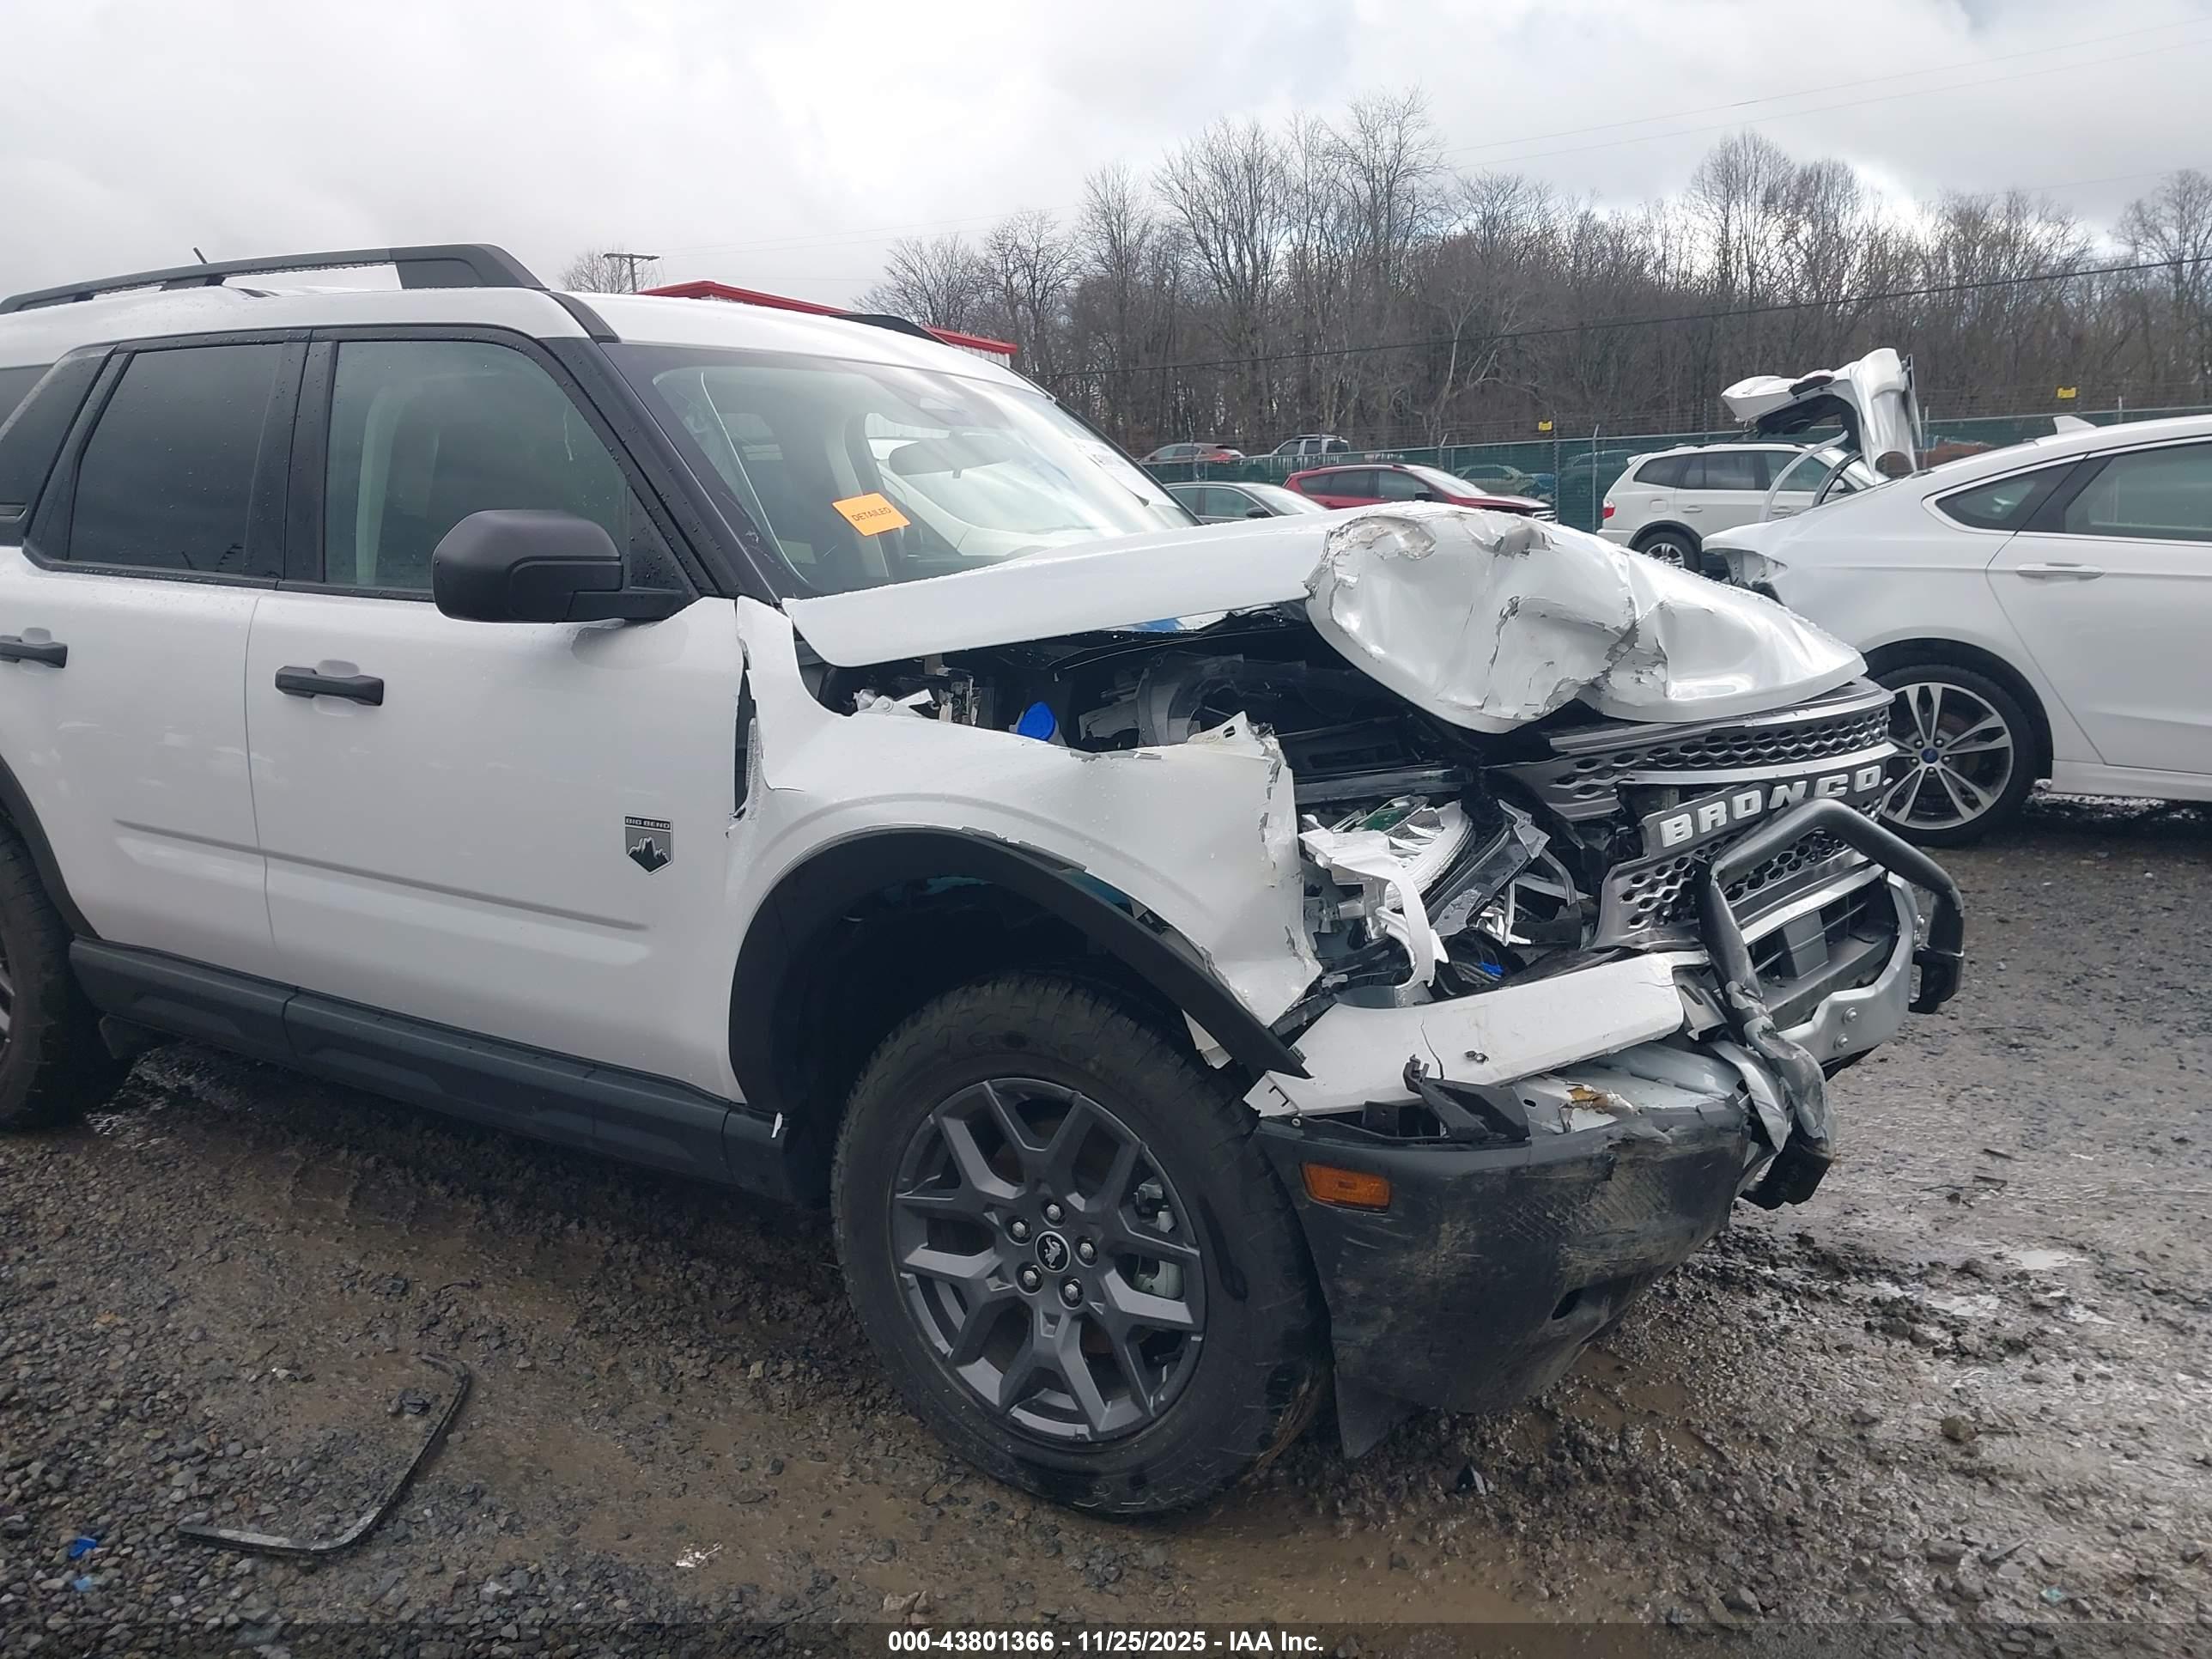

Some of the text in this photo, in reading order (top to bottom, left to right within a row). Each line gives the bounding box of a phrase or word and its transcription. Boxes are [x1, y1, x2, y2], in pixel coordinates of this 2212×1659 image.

[852, 507, 891, 521] DETAILED
[1659, 765, 1881, 848] BRONCO
[643, 820, 671, 829] BEND
